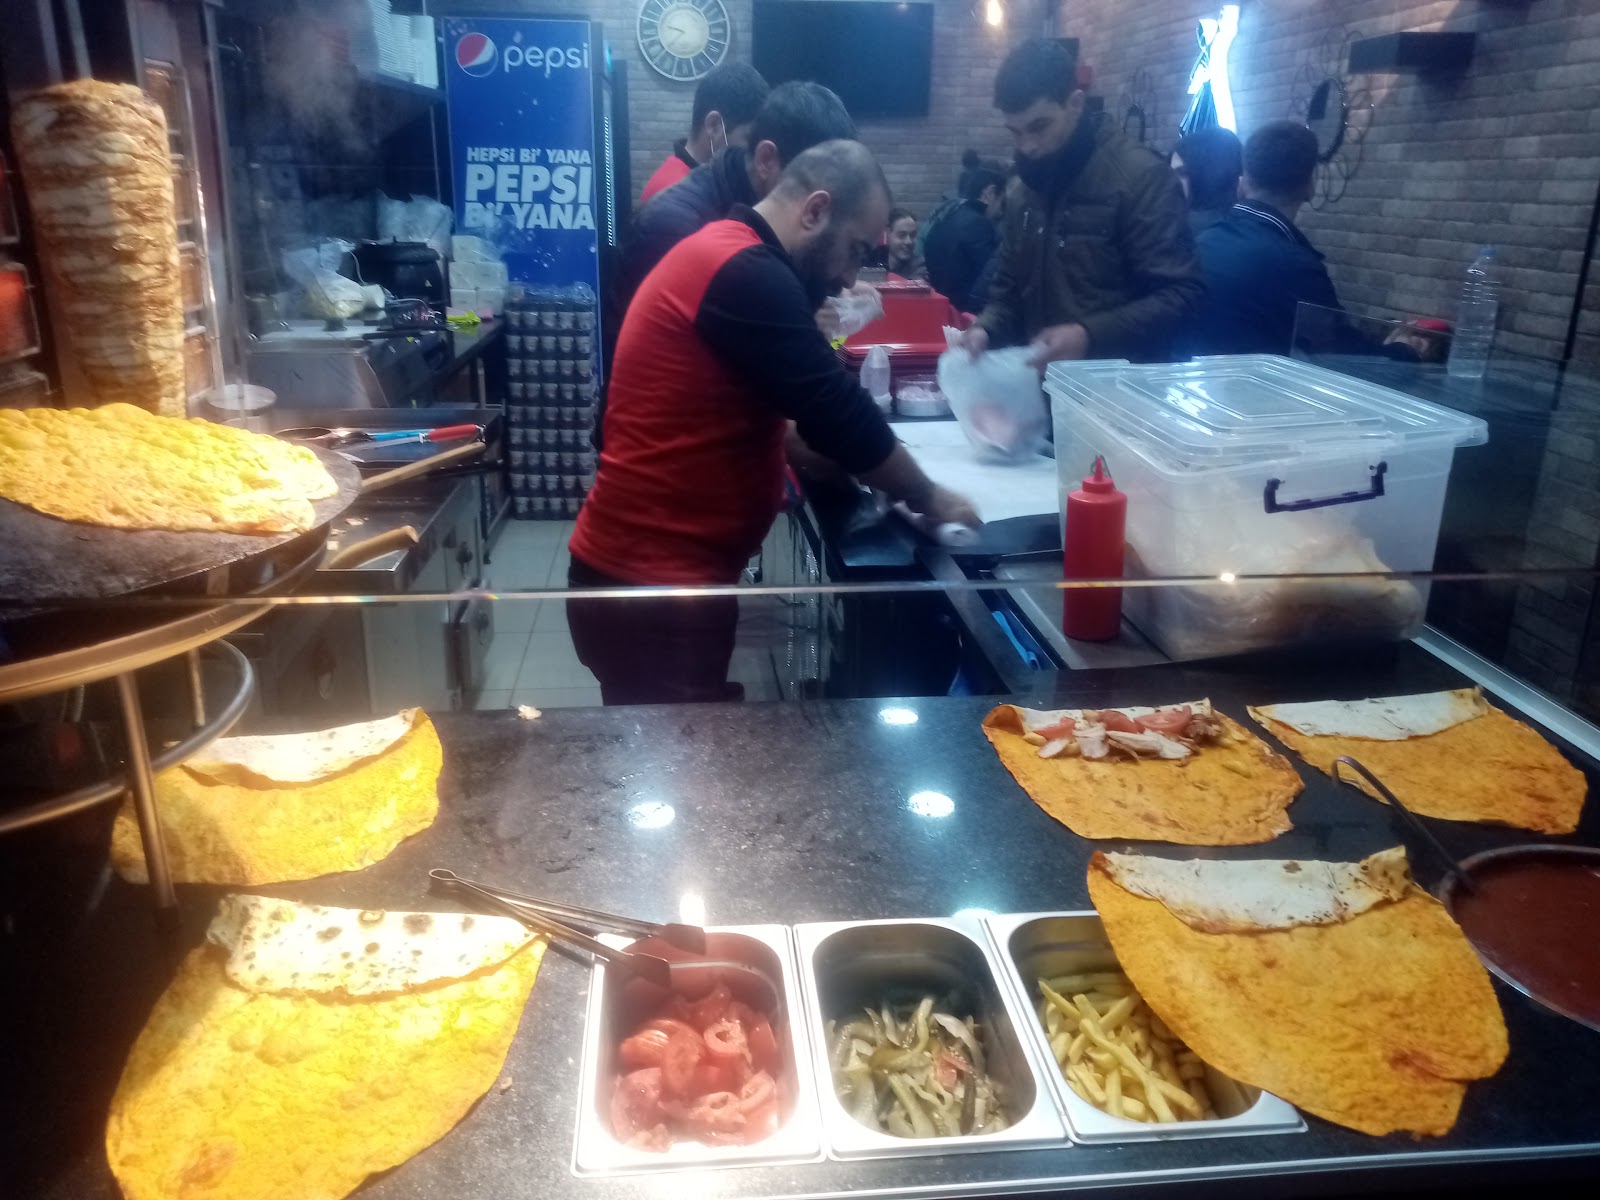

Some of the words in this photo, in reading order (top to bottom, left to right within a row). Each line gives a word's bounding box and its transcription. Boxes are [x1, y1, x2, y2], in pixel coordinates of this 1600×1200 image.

[504, 43, 589, 75] pepsi
[546, 149, 591, 164] YANA
[465, 164, 592, 204] PEPSI
[510, 203, 596, 230] YANA
